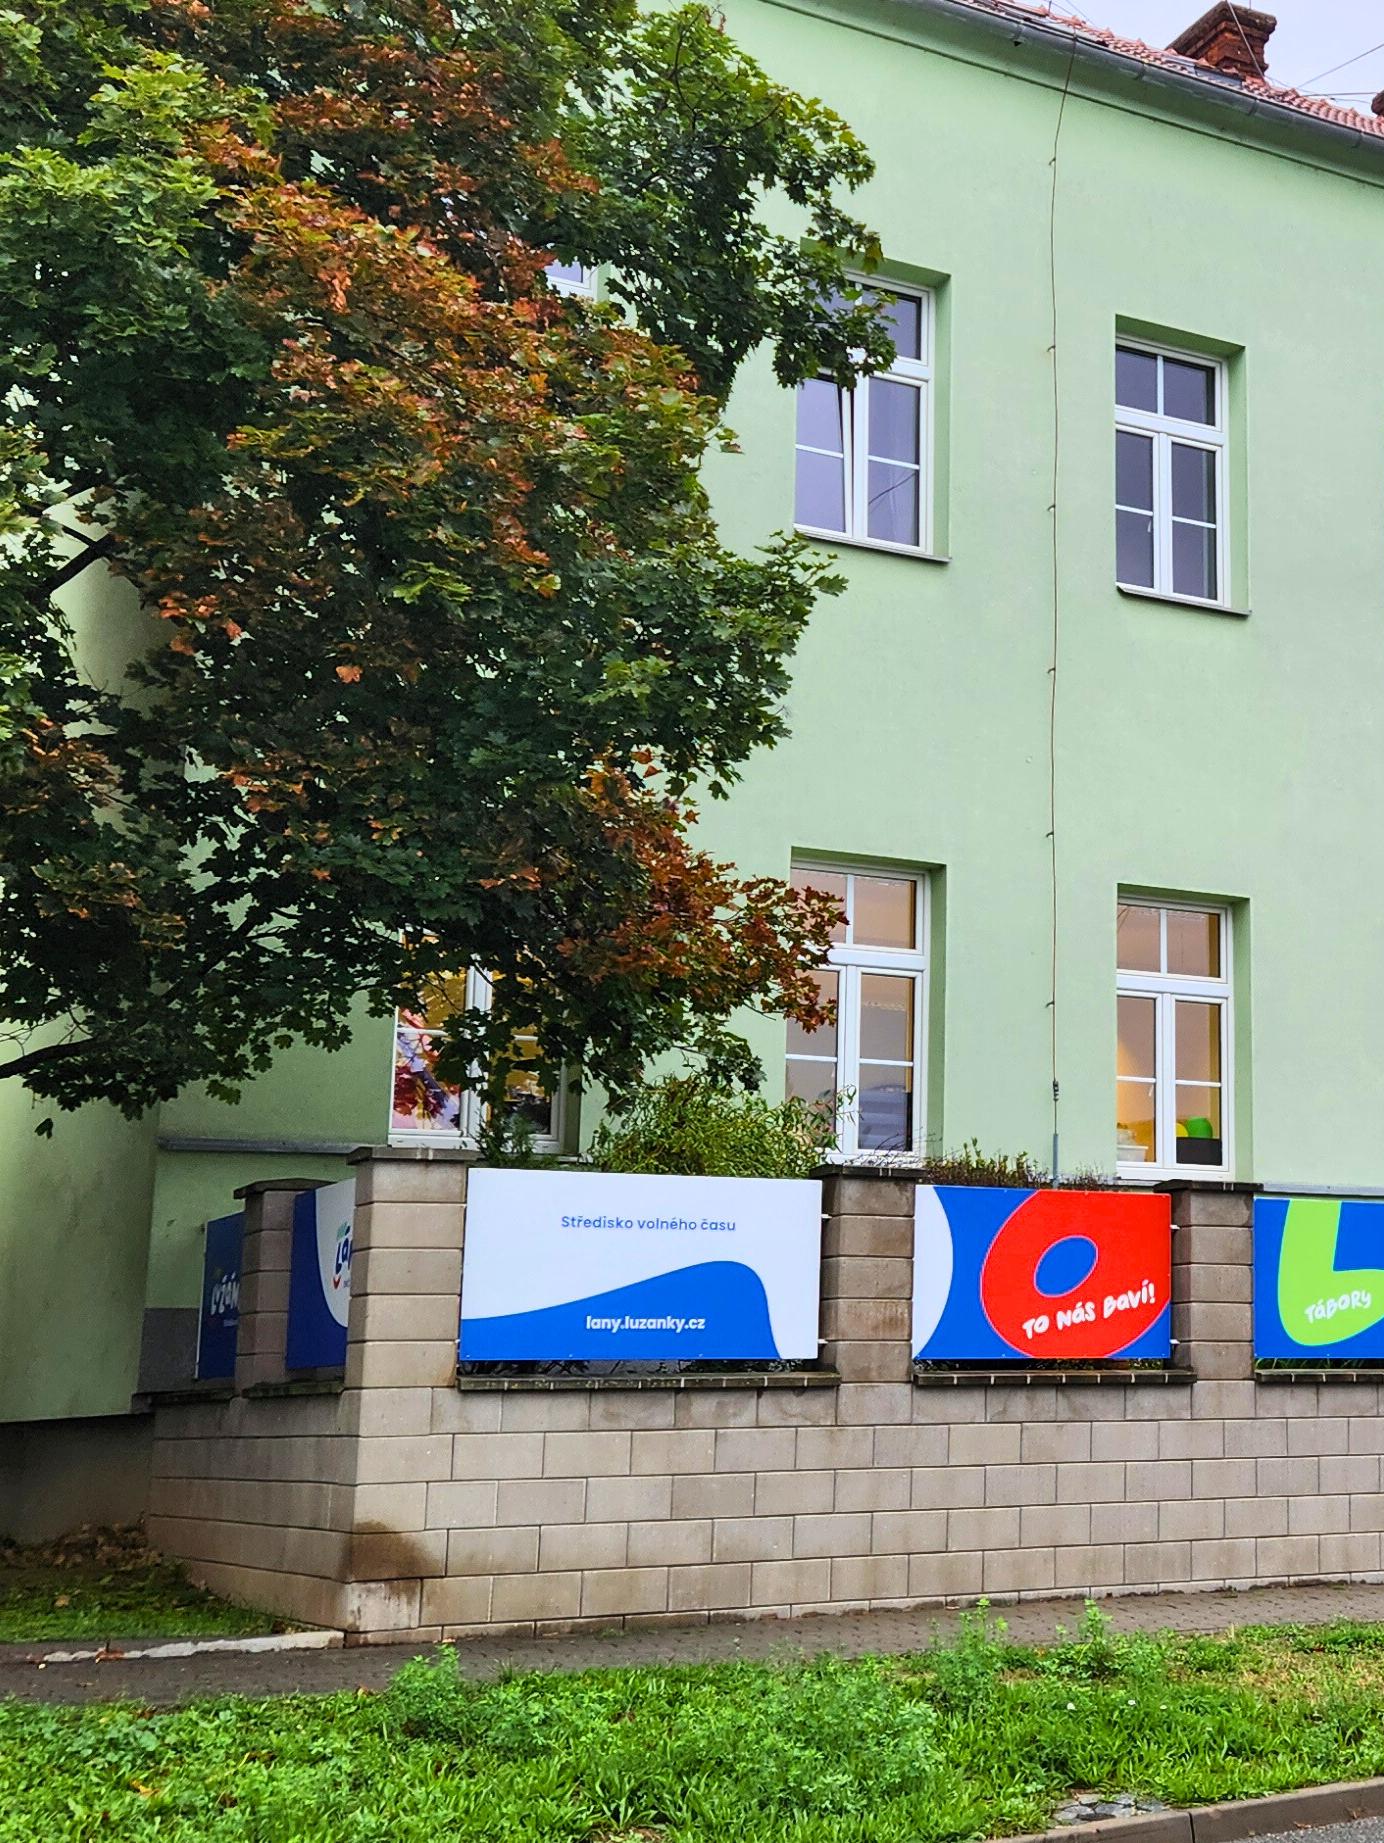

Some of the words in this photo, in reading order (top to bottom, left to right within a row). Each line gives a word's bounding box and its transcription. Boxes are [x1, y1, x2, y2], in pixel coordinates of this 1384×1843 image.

[561, 1215, 634, 1229] Středisko
[637, 1216, 697, 1231] volného
[700, 1217, 736, 1232] času
[585, 1315, 706, 1334] lany.luzanky.cz
